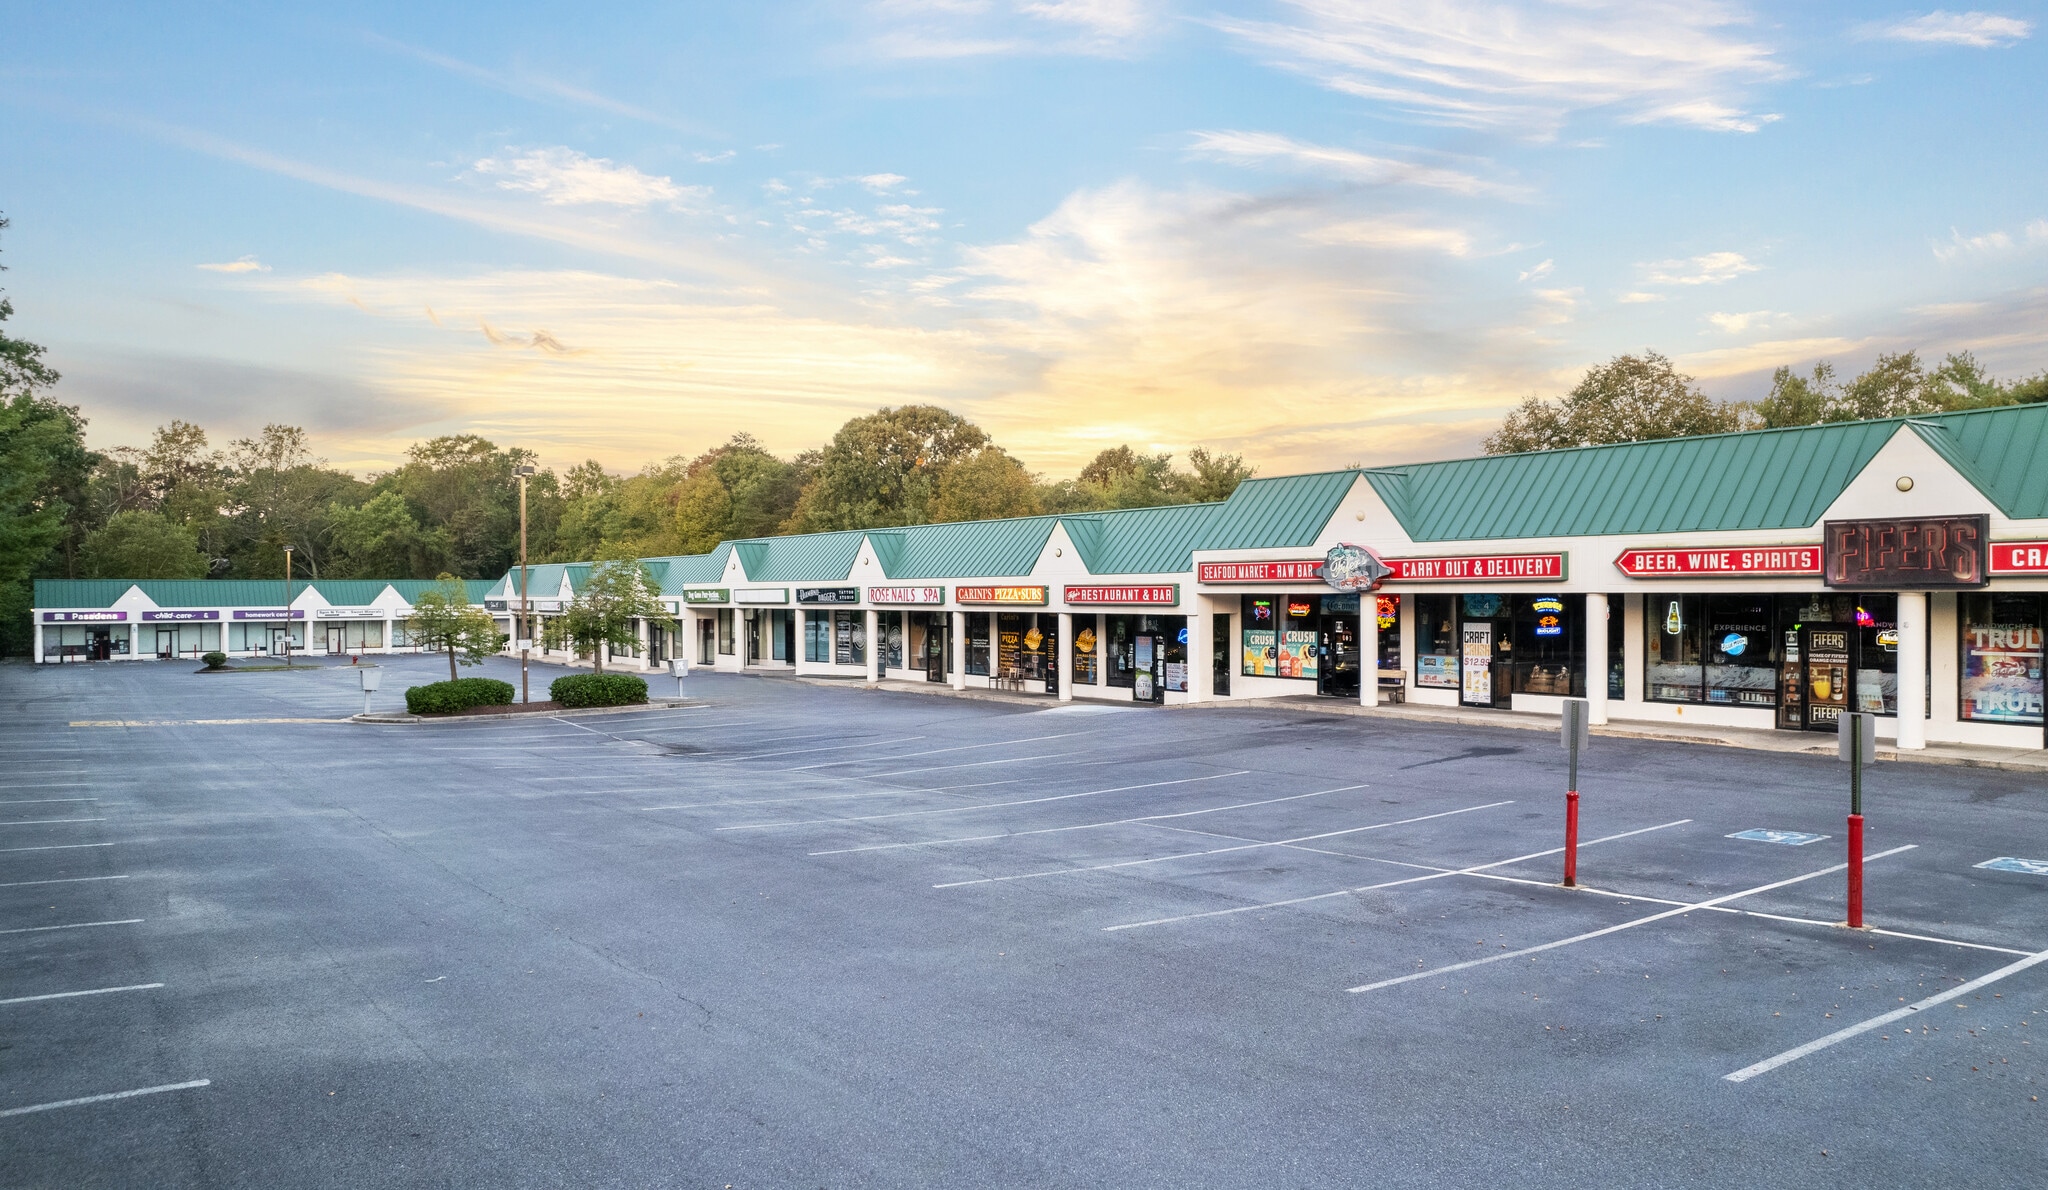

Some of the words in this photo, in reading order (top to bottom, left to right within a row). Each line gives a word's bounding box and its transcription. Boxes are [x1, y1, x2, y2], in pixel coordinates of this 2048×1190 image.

[1834, 521, 1977, 582] FIFER'S
[2012, 548, 2048, 567] CR
[1635, 554, 1682, 571] BEER,
[1687, 553, 1736, 571] WINE,
[1742, 551, 1811, 568] SPIRITS
[1204, 566, 1236, 579] SEAFOOD
[1238, 564, 1269, 579] MARKET
[1276, 564, 1295, 578] RAW
[1297, 564, 1313, 577] BAR
[1402, 561, 1441, 577] CARRY
[1445, 560, 1469, 576] OUT
[1473, 560, 1483, 576] &
[1487, 558, 1553, 576] DELIVERY
[870, 588, 890, 602] ROSE
[891, 587, 916, 602] NAILS
[923, 587, 939, 602] SPA
[958, 588, 992, 600] CARINI'S
[994, 588, 1018, 600] PIZZA
[1020, 588, 1042, 600] SUBS
[1081, 589, 1139, 601] RESTAURANT
[1142, 589, 1150, 601] &
[1153, 589, 1172, 601] BAR
[1326, 600, 1355, 612] Coona
[1812, 603, 1820, 612] 3
[72, 612, 118, 620] Pasadena
[1714, 624, 1767, 632] EXPERIENCE
[1972, 622, 2034, 630] SANDWICHES
[1001, 635, 1018, 644] PIZZA
[1250, 635, 1275, 645] CRUSH
[1286, 630, 1316, 643] CRUSH
[1464, 631, 1490, 644] CRAFT
[1464, 644, 1490, 656] CRUSH
[1464, 657, 1490, 666] $12.99
